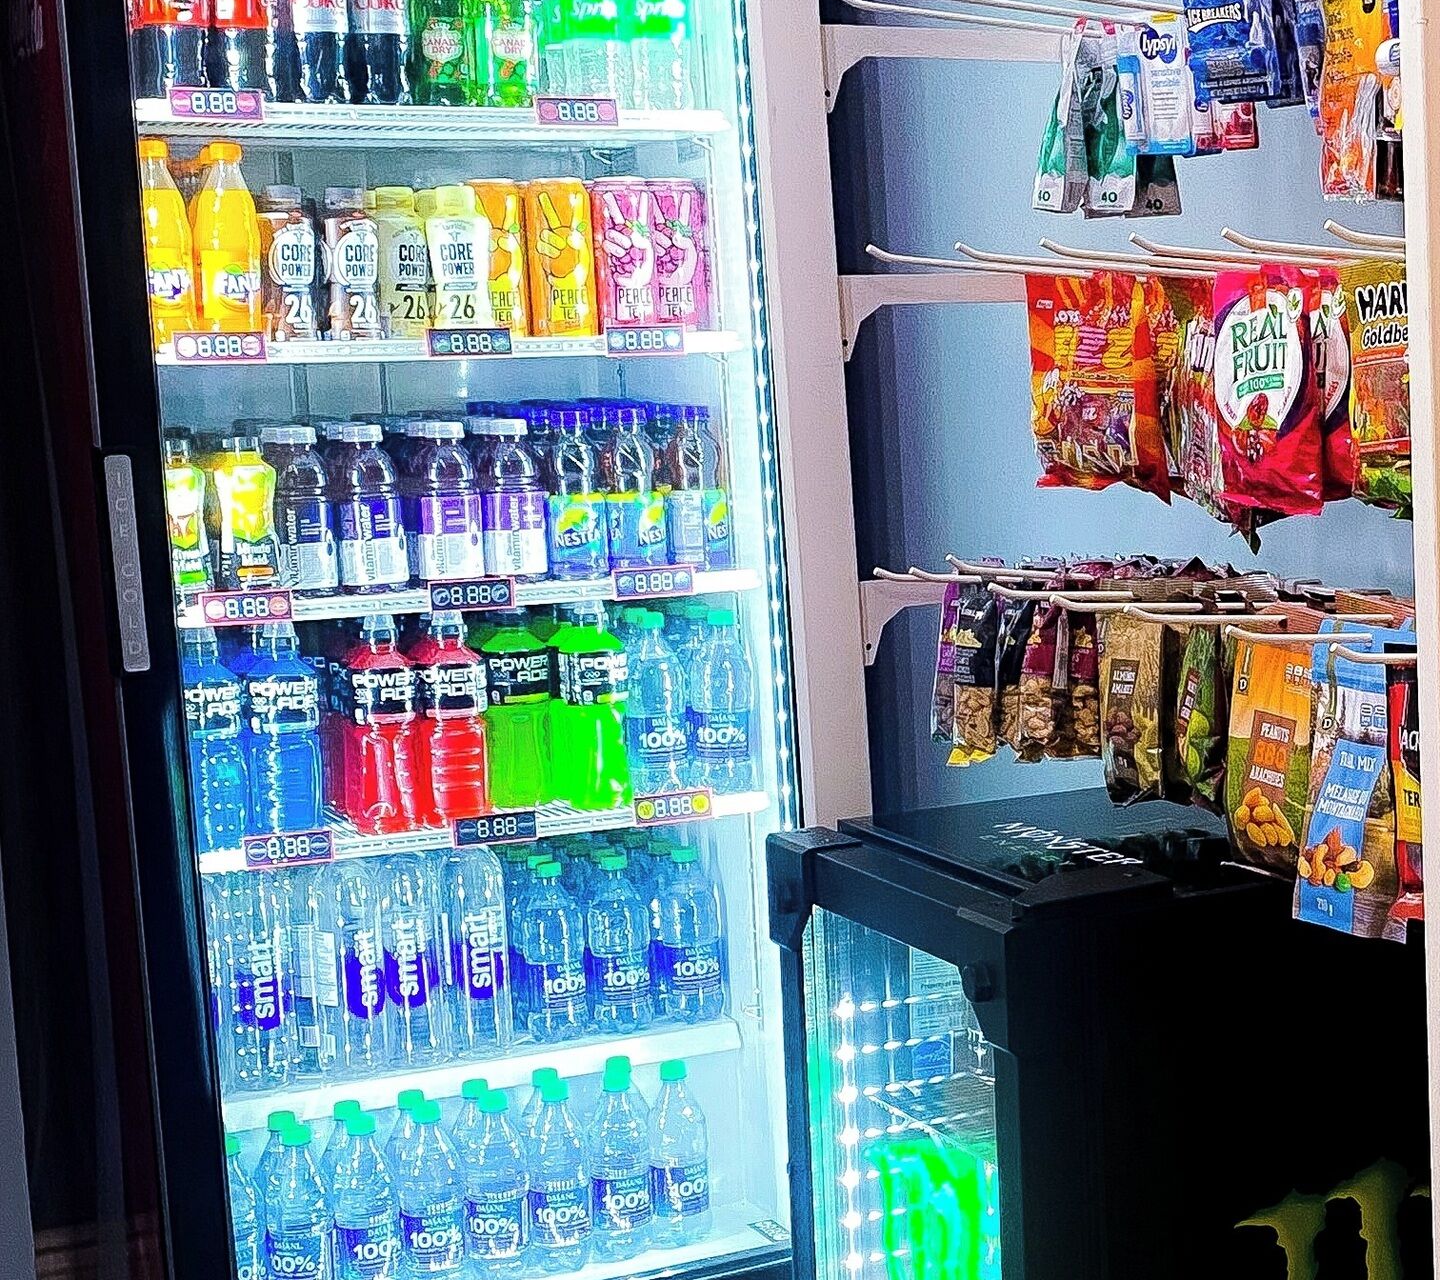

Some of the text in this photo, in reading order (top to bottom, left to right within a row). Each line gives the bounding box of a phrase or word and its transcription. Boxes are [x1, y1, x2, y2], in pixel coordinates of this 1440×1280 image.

[1187, 3, 1241, 26] ICE BREAKERS
[1101, 191, 1118, 204] 40
[1145, 198, 1163, 211] 40
[281, 243, 312, 262] CORE
[345, 243, 375, 262] CORE
[398, 244, 426, 262] CORE
[440, 242, 474, 261] CORE
[552, 289, 587, 306] PEACE
[618, 287, 651, 305] PEACE
[658, 287, 692, 304] PEACE
[284, 294, 313, 322] 26
[350, 294, 378, 322] 26
[403, 294, 426, 320] 26
[449, 294, 476, 320] 26
[1231, 312, 1288, 355] REAL
[1233, 342, 1289, 385] FRUIT
[489, 654, 549, 671] POWER
[516, 669, 548, 683] ADE
[697, 726, 746, 744] 100%
[1357, 754, 1378, 771] MIX
[393, 916, 418, 997] smart
[464, 909, 492, 990] smart
[355, 929, 378, 1008] smart
[673, 959, 720, 976] 100%
[603, 969, 650, 988] 100%
[535, 1203, 586, 1226] 100%
[468, 1214, 520, 1235] 100%
[409, 1227, 463, 1250] 100%
